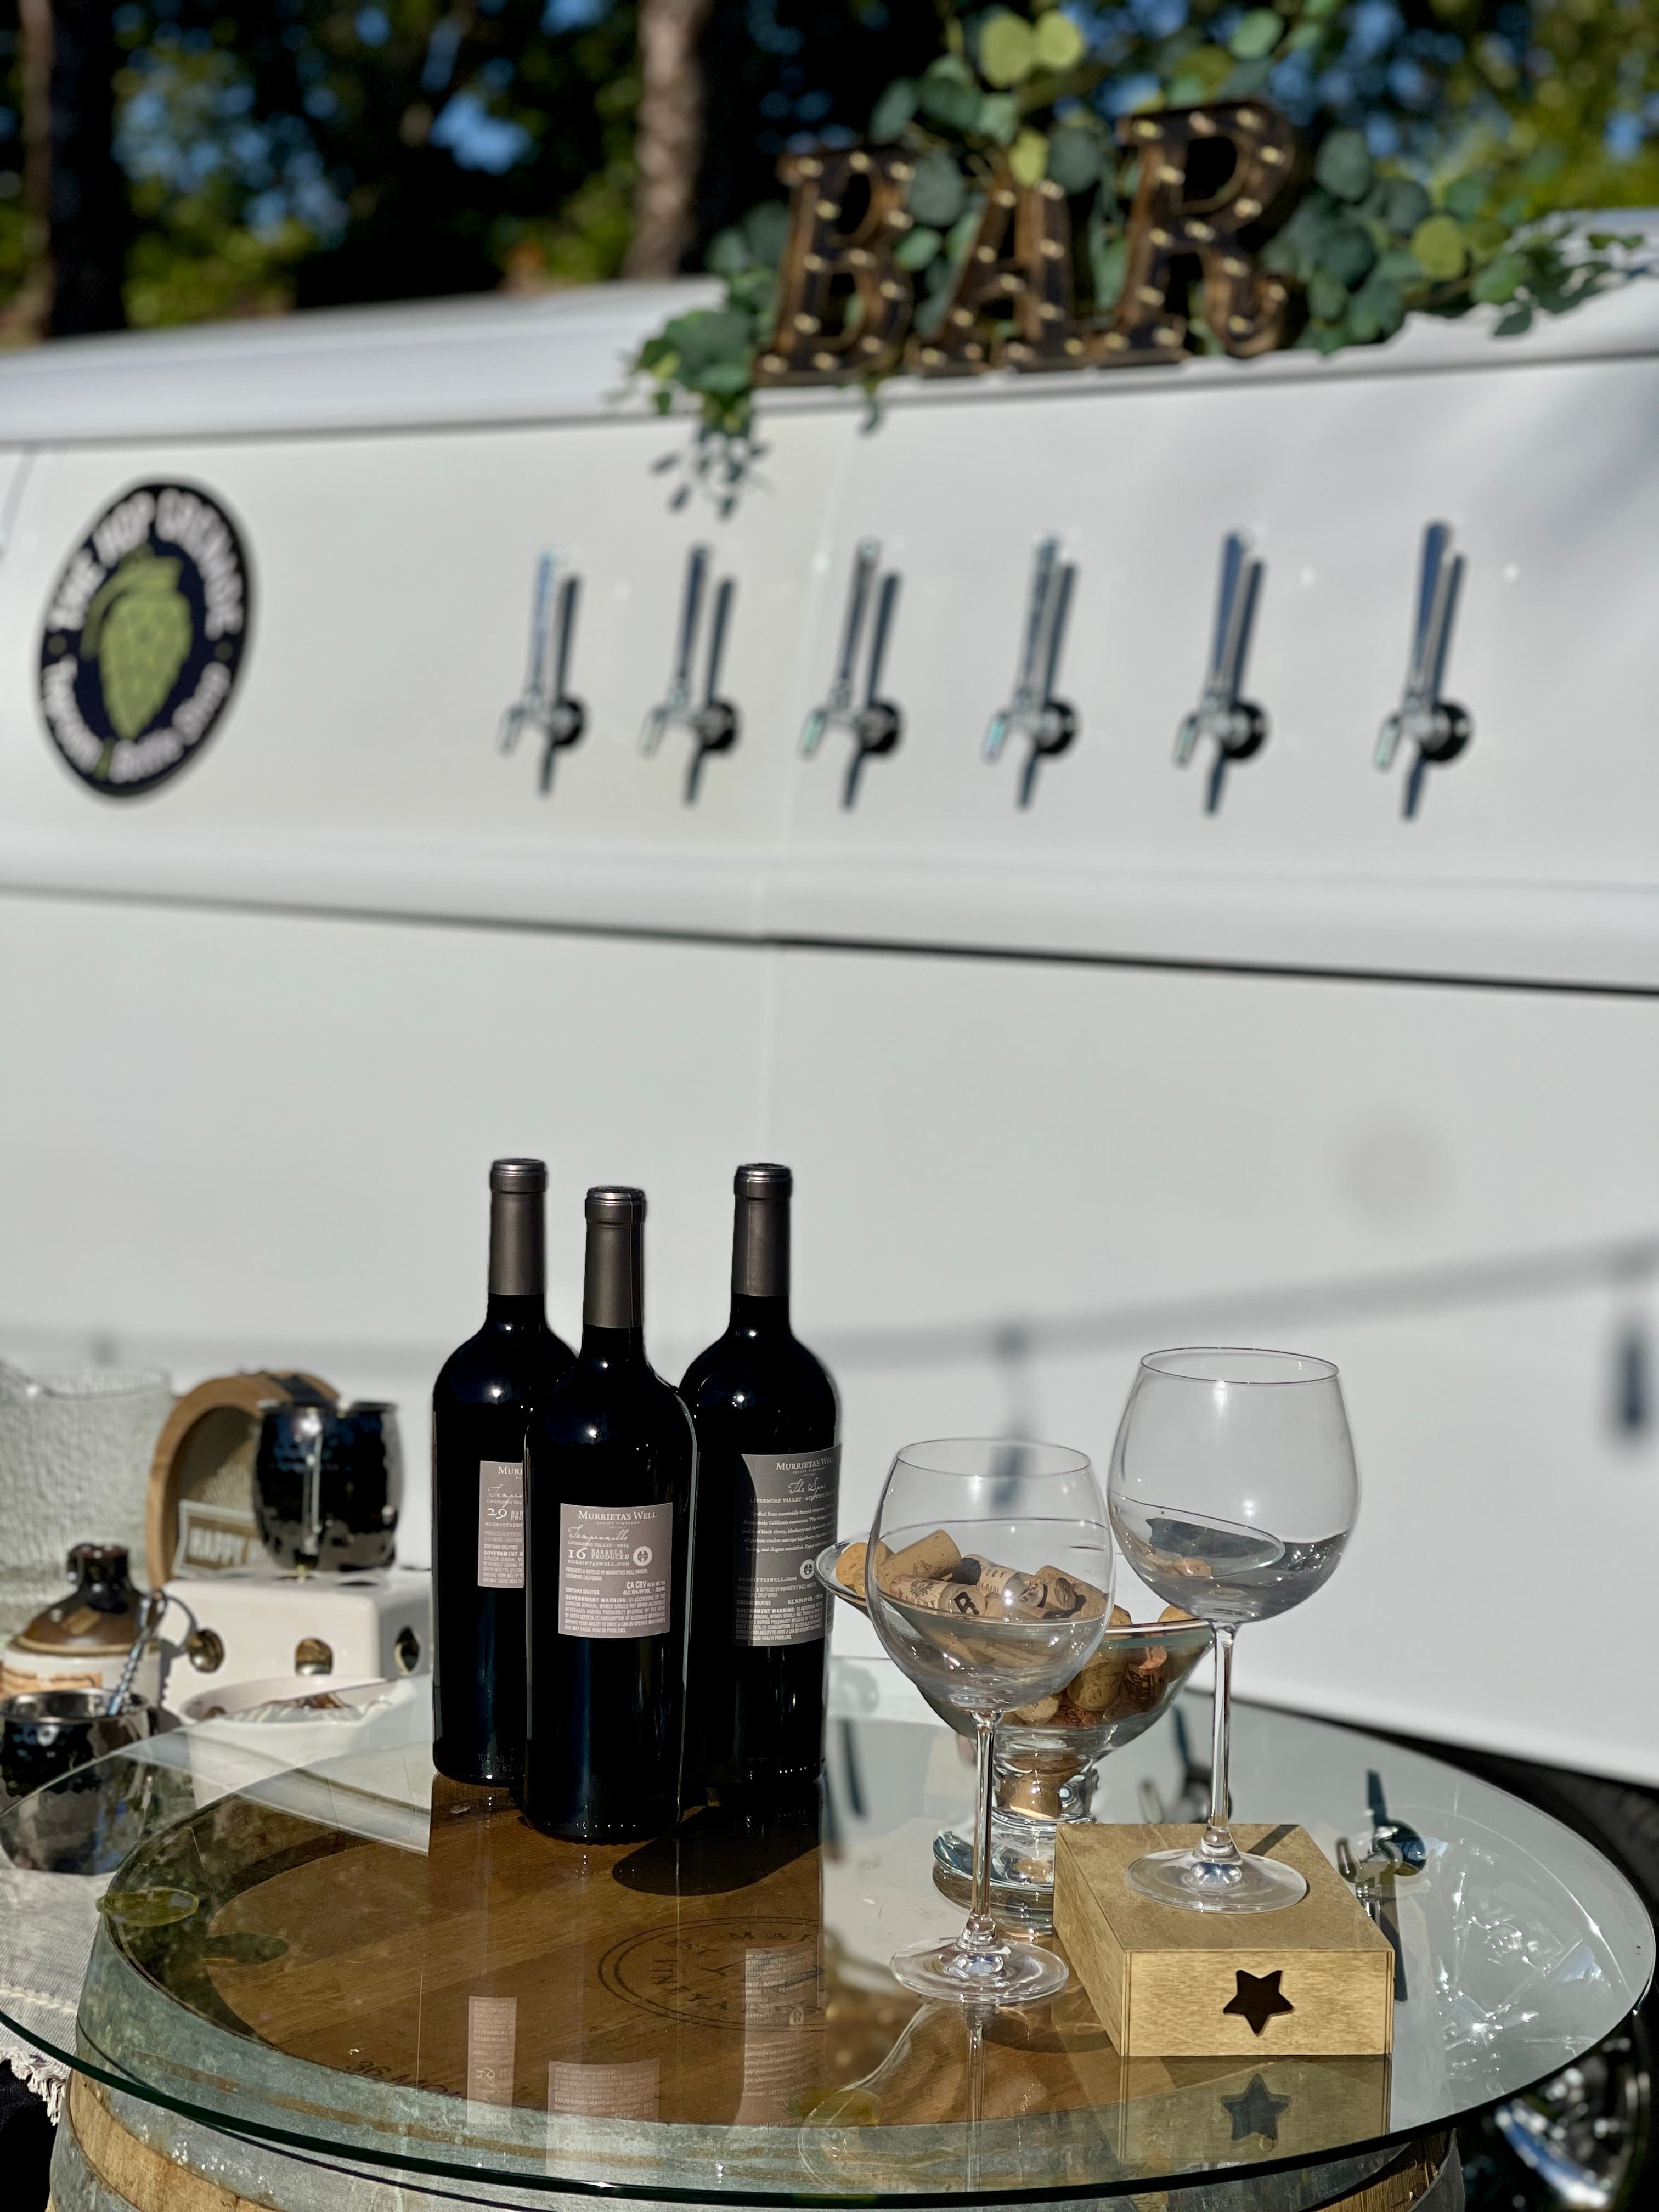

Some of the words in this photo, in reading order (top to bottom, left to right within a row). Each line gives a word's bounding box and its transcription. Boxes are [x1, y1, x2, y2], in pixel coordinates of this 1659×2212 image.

[753, 100, 1300, 385] BAR
[788, 1479, 805, 1494] The
[487, 1508, 507, 1519] 29
[634, 1511, 657, 1519] WELL
[568, 1548, 588, 1559] 16
[635, 1580, 647, 1588] CRV
[566, 1594, 600, 1602] GOVERNMENT
